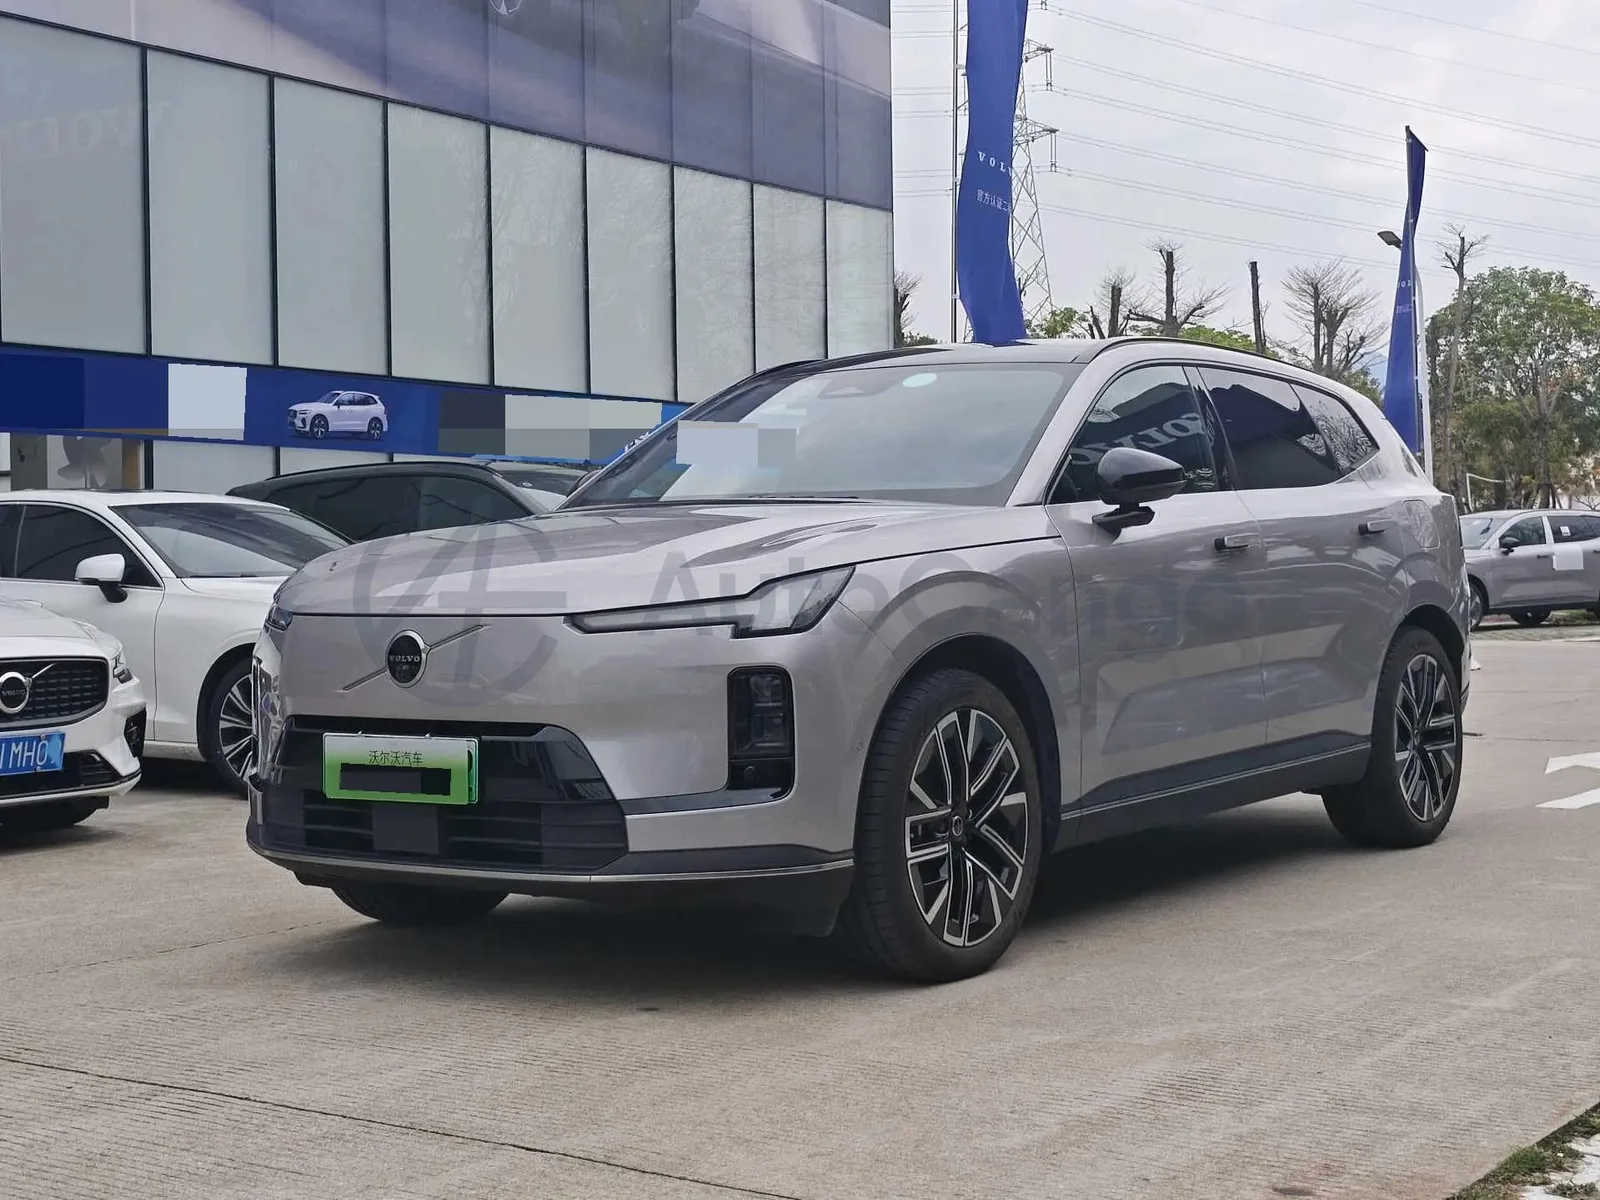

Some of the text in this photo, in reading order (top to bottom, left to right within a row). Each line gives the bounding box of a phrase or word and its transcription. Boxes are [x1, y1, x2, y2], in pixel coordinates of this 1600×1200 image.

[389, 655, 420, 663] VOLVO
[368, 750, 423, 766] 沃尔沃汽车
